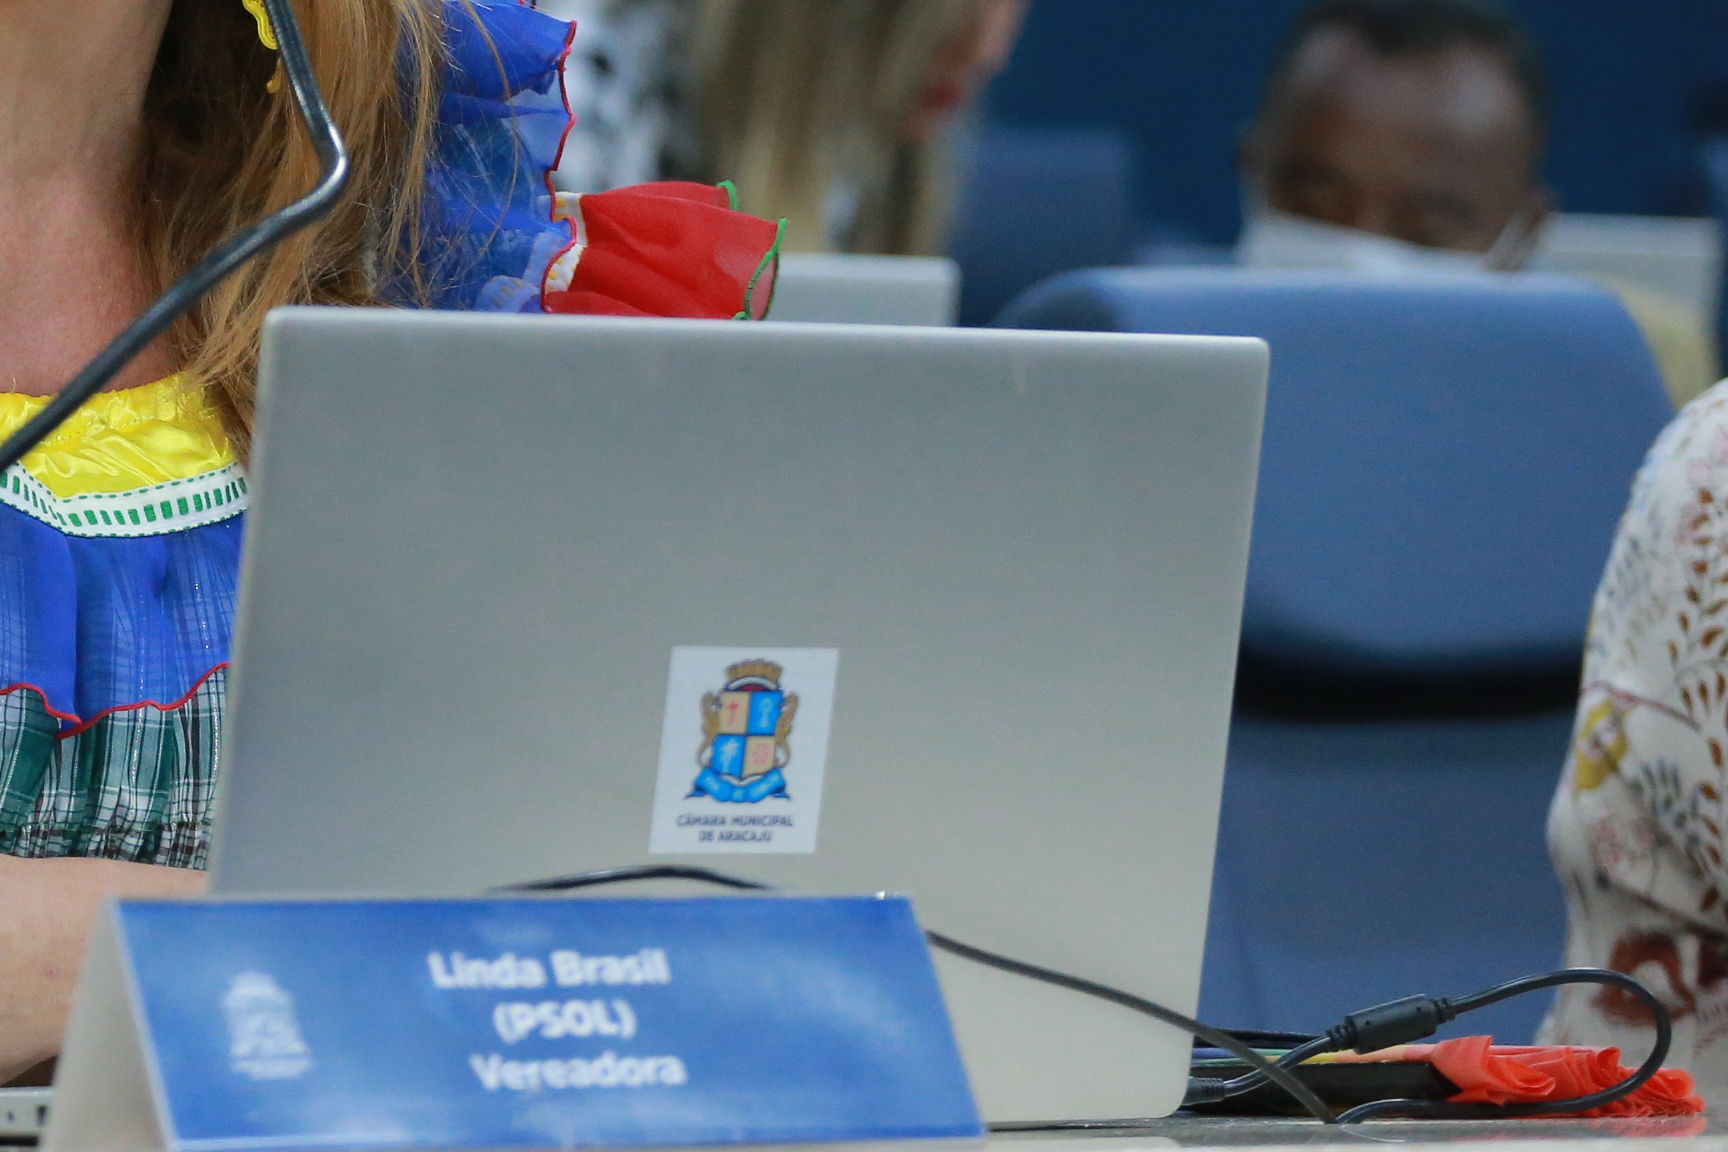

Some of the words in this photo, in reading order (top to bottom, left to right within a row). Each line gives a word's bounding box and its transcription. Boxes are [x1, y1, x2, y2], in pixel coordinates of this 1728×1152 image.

[676, 812, 726, 826] CÂMARA
[730, 813, 793, 827] MUNICIPAL
[699, 830, 714, 842] DE
[717, 830, 772, 842] ARACAJU
[428, 951, 547, 989] Linda
[552, 949, 671, 986] Brasil
[493, 999, 637, 1044] (PSOL)
[470, 1050, 688, 1091] Vereadora
